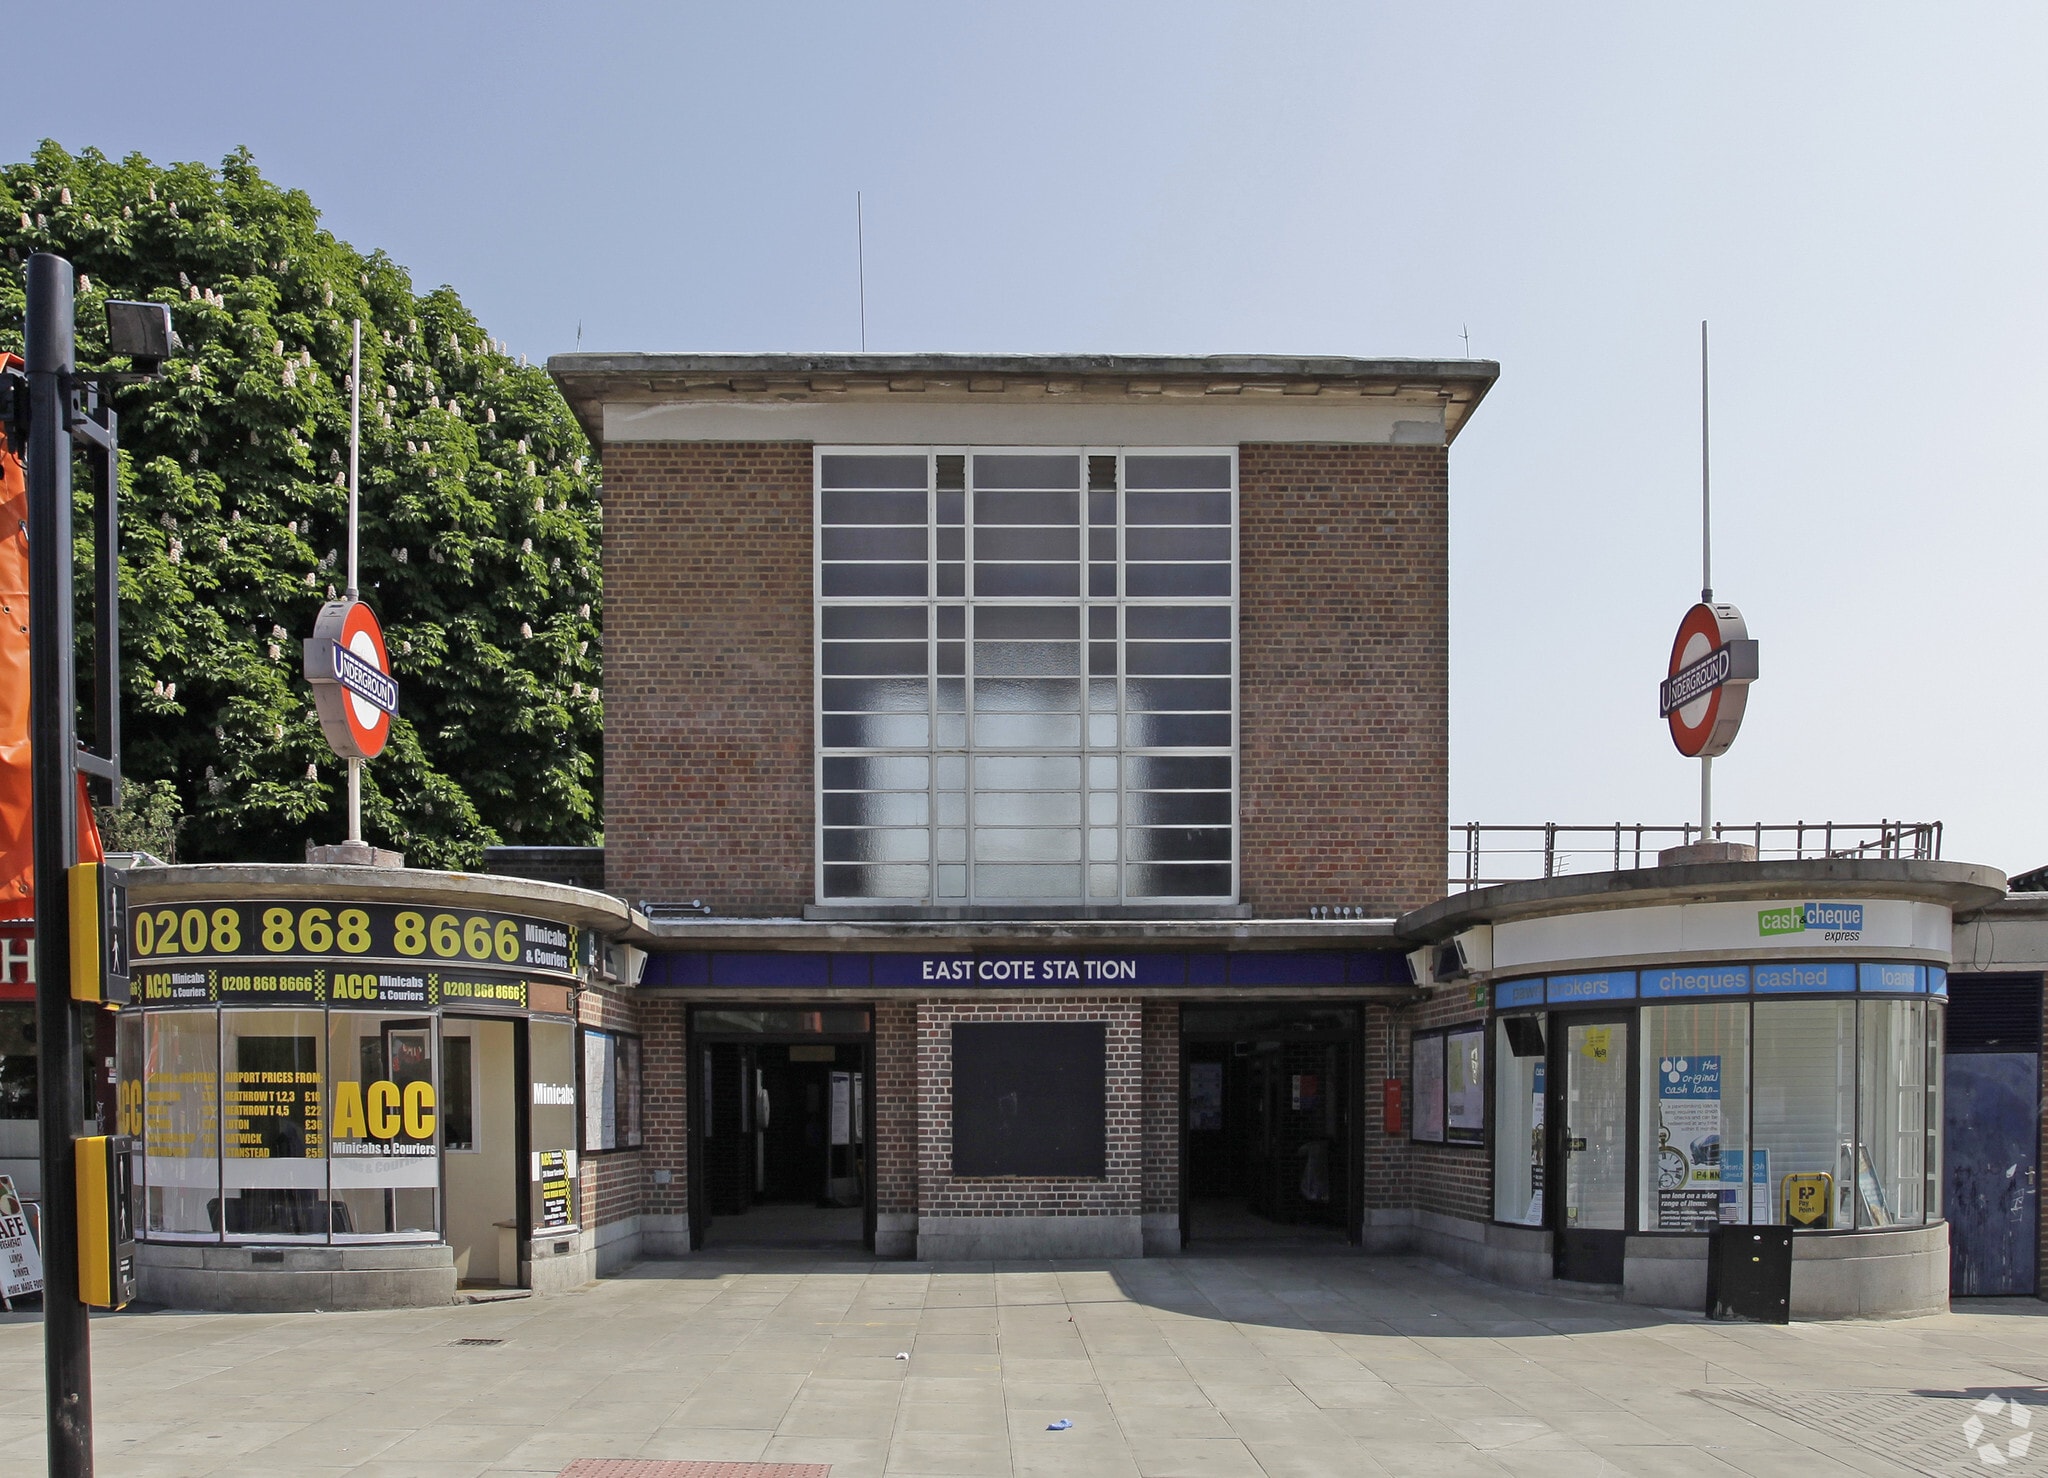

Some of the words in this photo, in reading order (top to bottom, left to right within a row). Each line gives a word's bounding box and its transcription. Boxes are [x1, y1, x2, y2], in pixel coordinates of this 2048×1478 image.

[333, 645, 397, 711] UNDERGROUND
[1662, 650, 1729, 711] UNDERGROUND
[1762, 906, 1800, 929] cash
[1800, 916, 1806, 924] &
[1806, 903, 1861, 930] cheque
[136, 908, 241, 955] 0208
[262, 908, 372, 954] 868
[394, 911, 520, 962] 8666
[525, 924, 567, 948] Minicabs
[1824, 931, 1860, 942] express
[526, 949, 534, 962] &
[534, 948, 568, 968] Couriers
[172, 972, 205, 984] Minicabs
[380, 975, 424, 988] Minicabs
[1660, 972, 1747, 992] cheques
[1756, 967, 1828, 987] cashed
[1882, 967, 1914, 986] loans
[146, 973, 172, 998] ACC
[222, 976, 251, 991] 0208
[253, 976, 277, 991] 868
[280, 976, 312, 992] 8666
[332, 974, 378, 1000] ACC
[443, 982, 472, 997] 0208
[474, 983, 494, 998] 868
[495, 985, 520, 1000] 8666
[1550, 978, 1609, 997] brokers
[178, 987, 206, 998] Couriers
[380, 990, 386, 1000] &
[387, 990, 424, 1000] Couriers
[1702, 1061, 1718, 1072] the
[224, 1072, 260, 1083] AIRPORT
[262, 1072, 294, 1083] PRICES
[295, 1072, 324, 1084] FROM:
[1682, 1072, 1718, 1084] original
[534, 1082, 574, 1104] Minicabs
[1665, 1084, 1688, 1094] cash
[224, 1091, 268, 1102] HEATHROW
[269, 1092, 275, 1101] T
[304, 1092, 320, 1102] £18
[224, 1105, 268, 1116] HEATHROW
[269, 1105, 275, 1115] T
[276, 1106, 289, 1116] 4,5
[305, 1106, 322, 1116] £22
[332, 1080, 436, 1140] ACC
[225, 1120, 250, 1130] LUTON
[225, 1134, 262, 1144] GATWICK
[305, 1134, 322, 1144] £55
[225, 1148, 270, 1158] STANSTEAD
[305, 1148, 323, 1158] £55
[332, 1142, 382, 1154] Minicabs
[383, 1143, 390, 1154] &
[393, 1142, 436, 1155] Couriers
[541, 1152, 552, 1166] ACC
